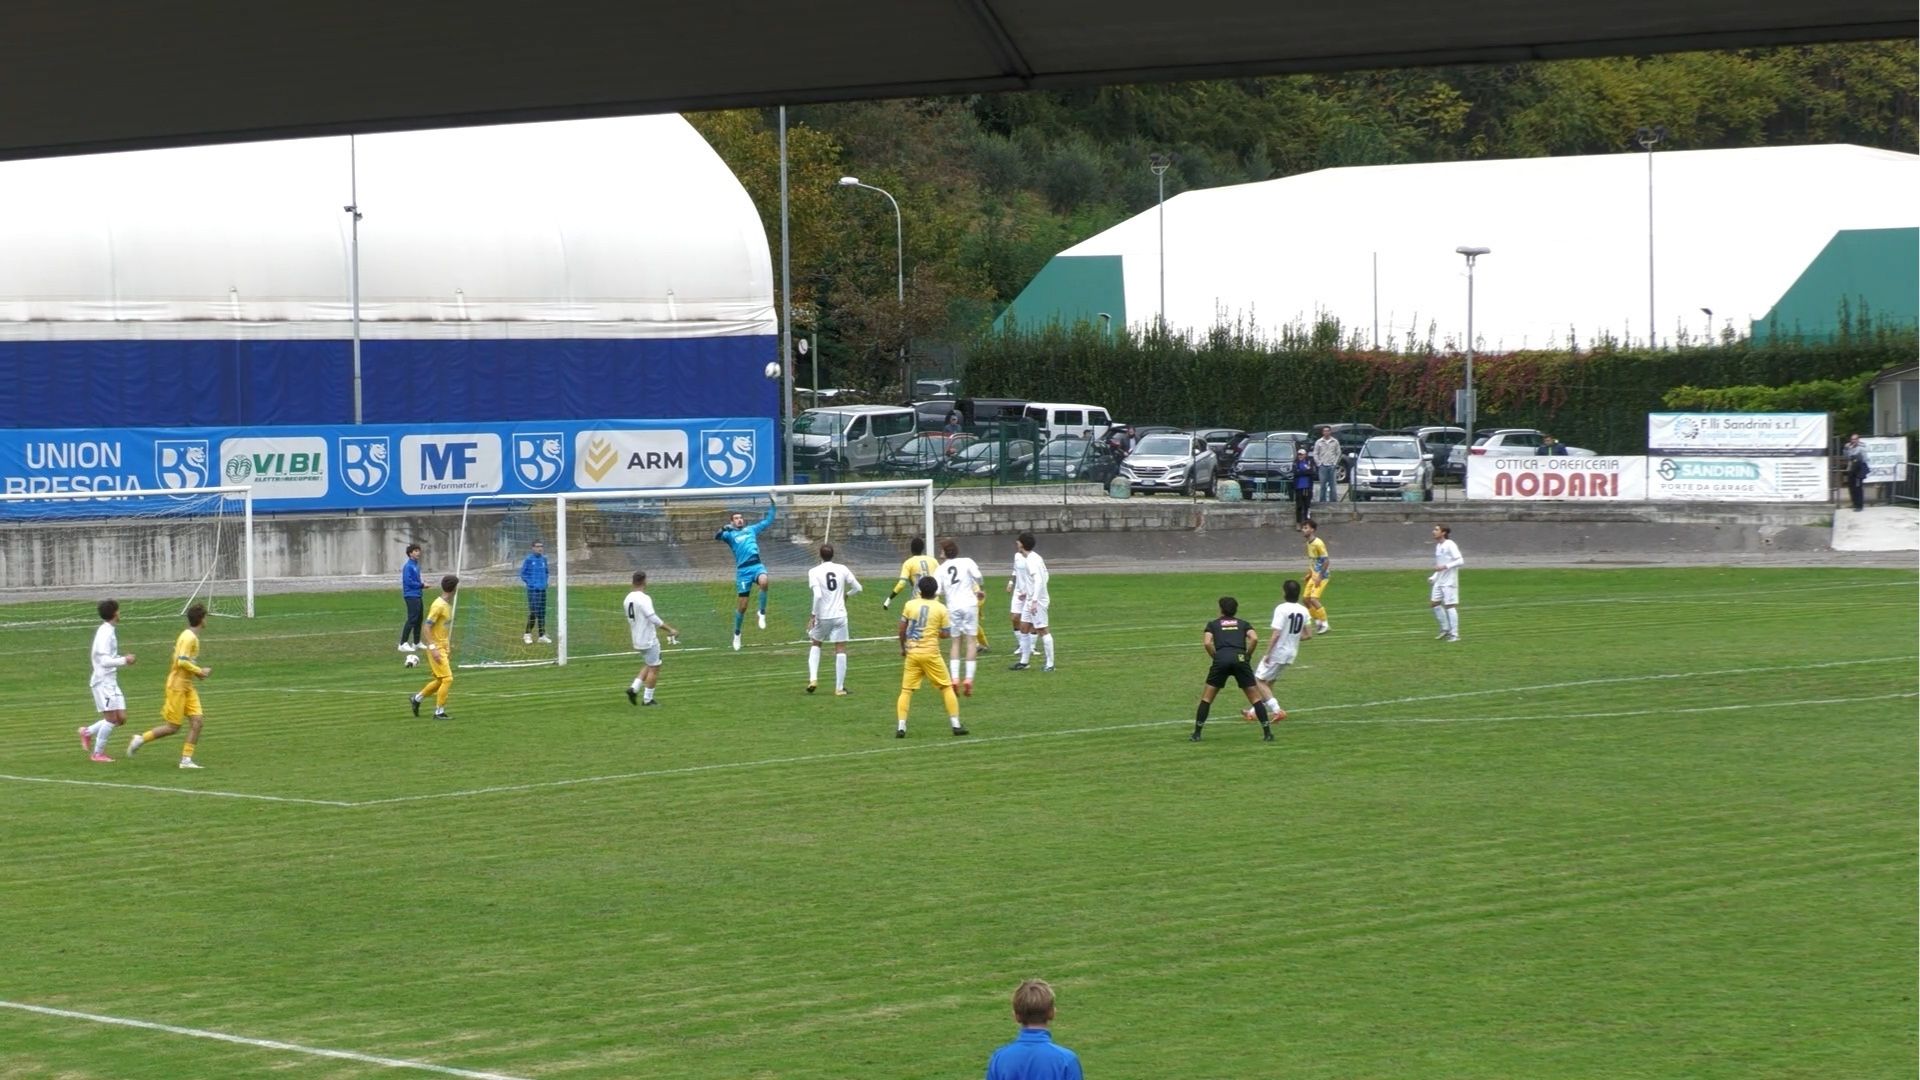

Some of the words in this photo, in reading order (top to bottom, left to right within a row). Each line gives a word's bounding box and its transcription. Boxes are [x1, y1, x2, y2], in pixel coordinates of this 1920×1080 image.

[1723, 418, 1772, 430] Sandrini
[26, 441, 122, 469] UNION
[420, 442, 478, 481] MF
[626, 450, 684, 471] ARM
[1495, 459, 1539, 470] OTTICA
[1548, 459, 1620, 470] OREFICERIA
[1681, 463, 1756, 478] SANDRINI
[4, 475, 145, 503] BRESCIA
[419, 481, 480, 490] Trasformatori
[1495, 472, 1619, 498] NODARI
[1660, 483, 1694, 491] PORTE
[1696, 483, 1710, 491] DA
[1713, 484, 1755, 492] GARAGE
[825, 571, 838, 592] 6
[947, 565, 960, 586] 2
[628, 601, 636, 621] 4
[1288, 612, 1304, 635] 10
[105, 697, 110, 707] 7
